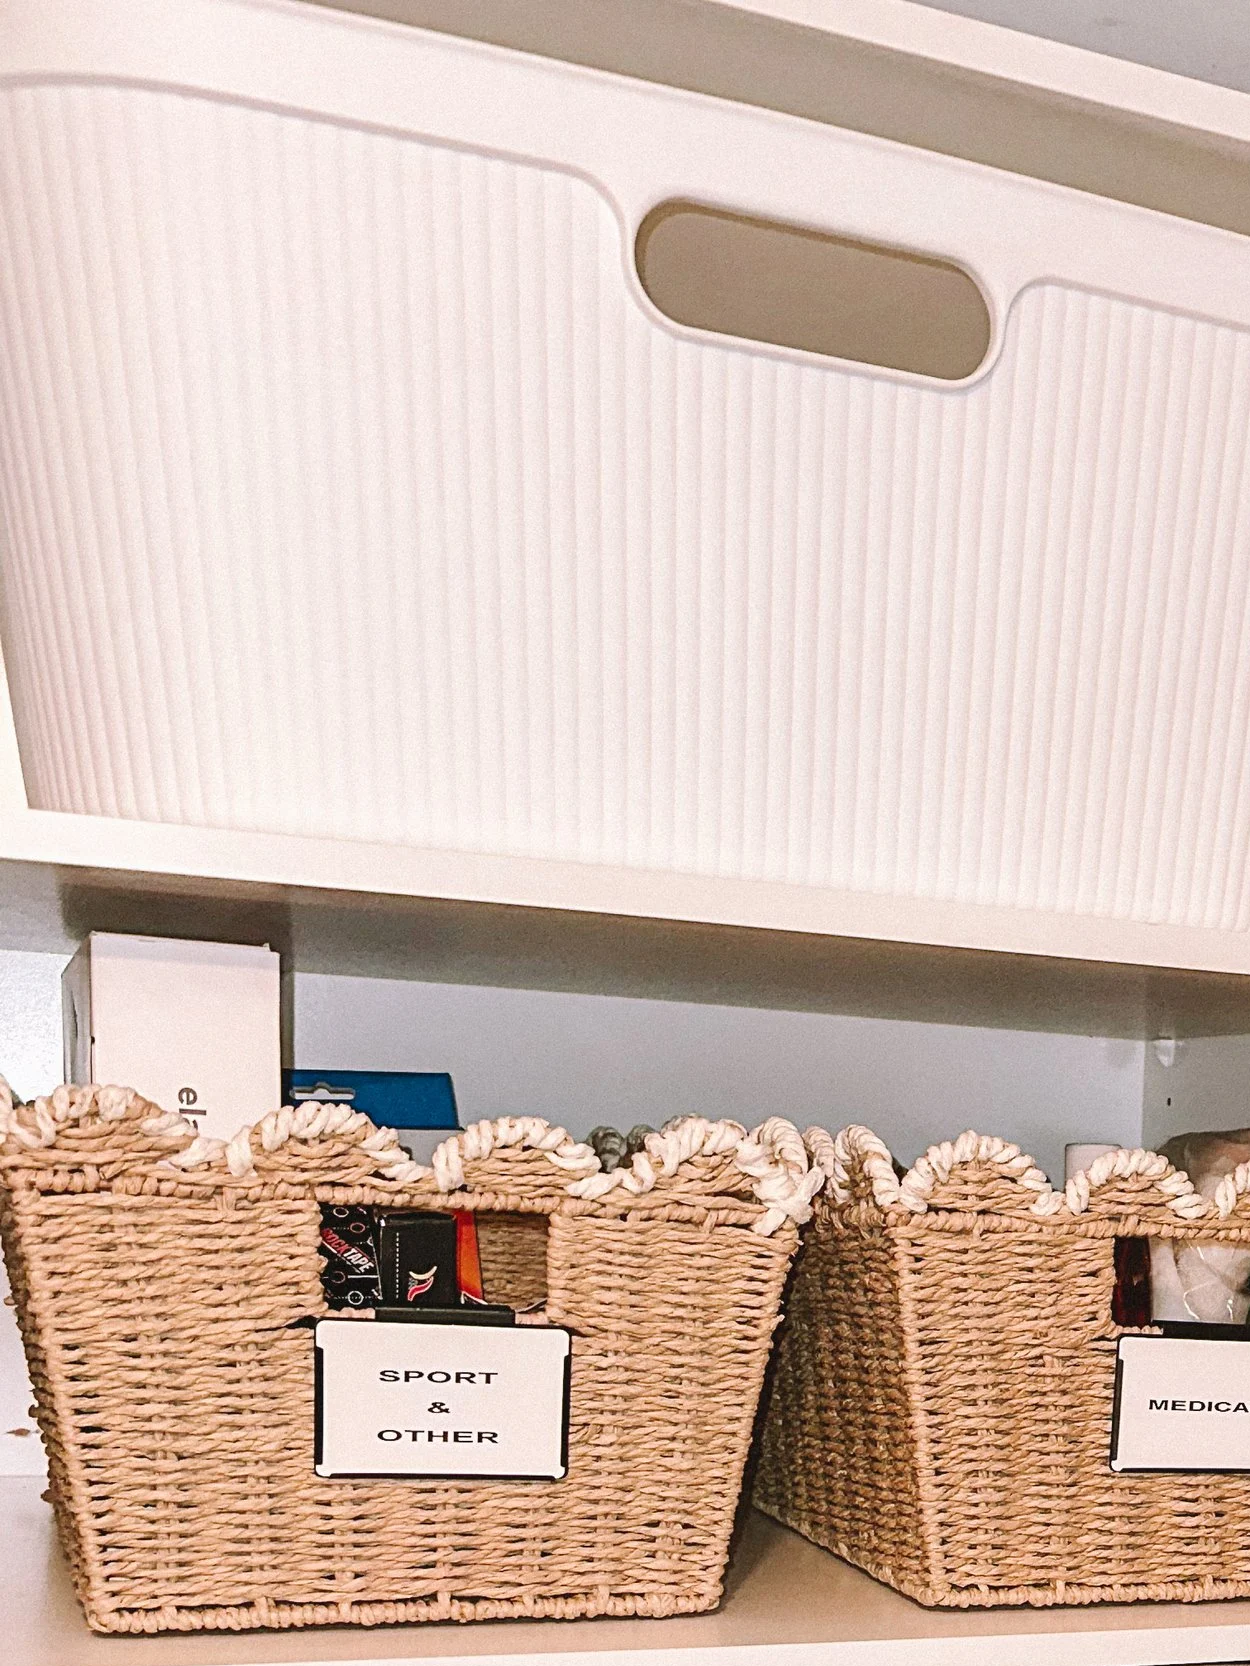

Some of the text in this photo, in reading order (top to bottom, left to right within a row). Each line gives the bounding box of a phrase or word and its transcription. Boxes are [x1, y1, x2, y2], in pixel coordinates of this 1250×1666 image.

[379, 1369, 499, 1385] SPORT
[427, 1401, 450, 1414] &
[377, 1429, 500, 1444] OTHER
